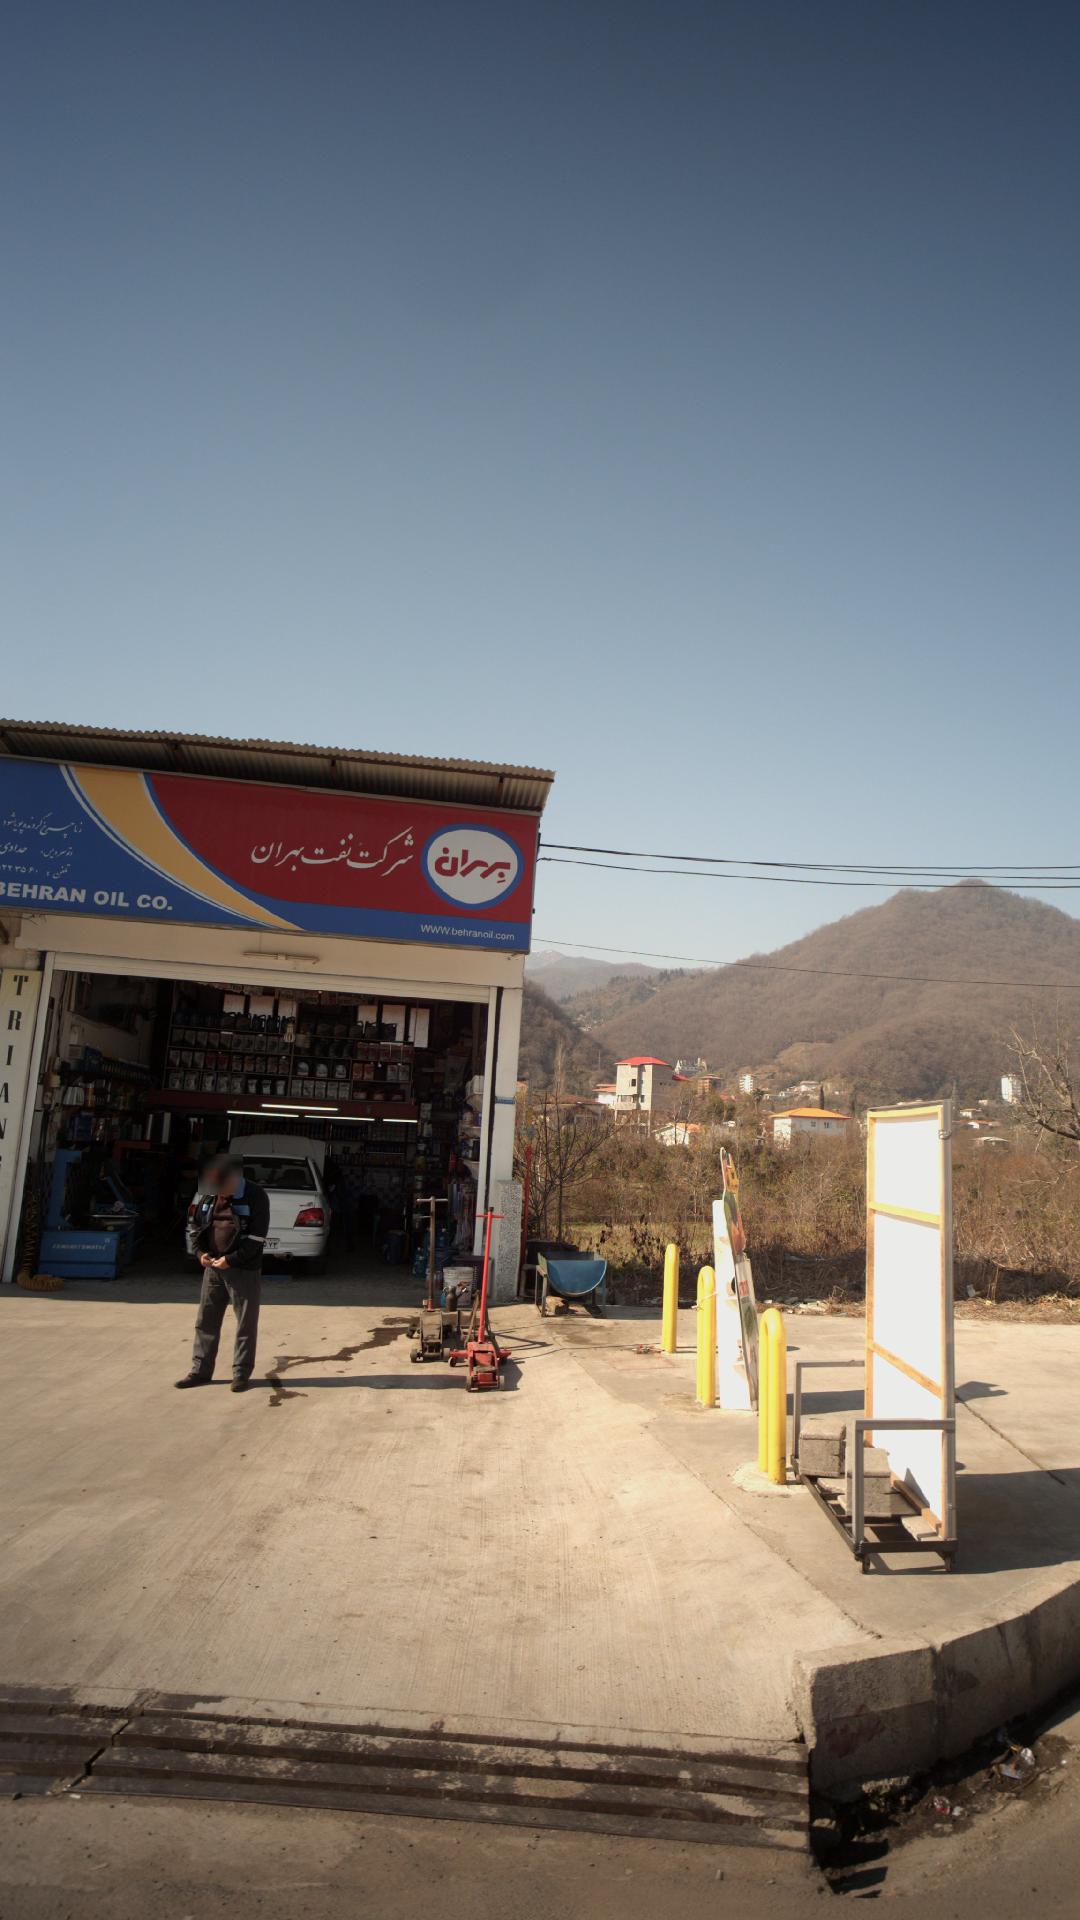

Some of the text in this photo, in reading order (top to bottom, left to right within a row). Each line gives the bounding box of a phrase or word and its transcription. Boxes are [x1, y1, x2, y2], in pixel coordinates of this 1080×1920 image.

[251, 826, 414, 876] شرکت نفت بهران
[434, 847, 511, 883] بهران
[0, 881, 173, 911] BEHRAN OIL CO.
